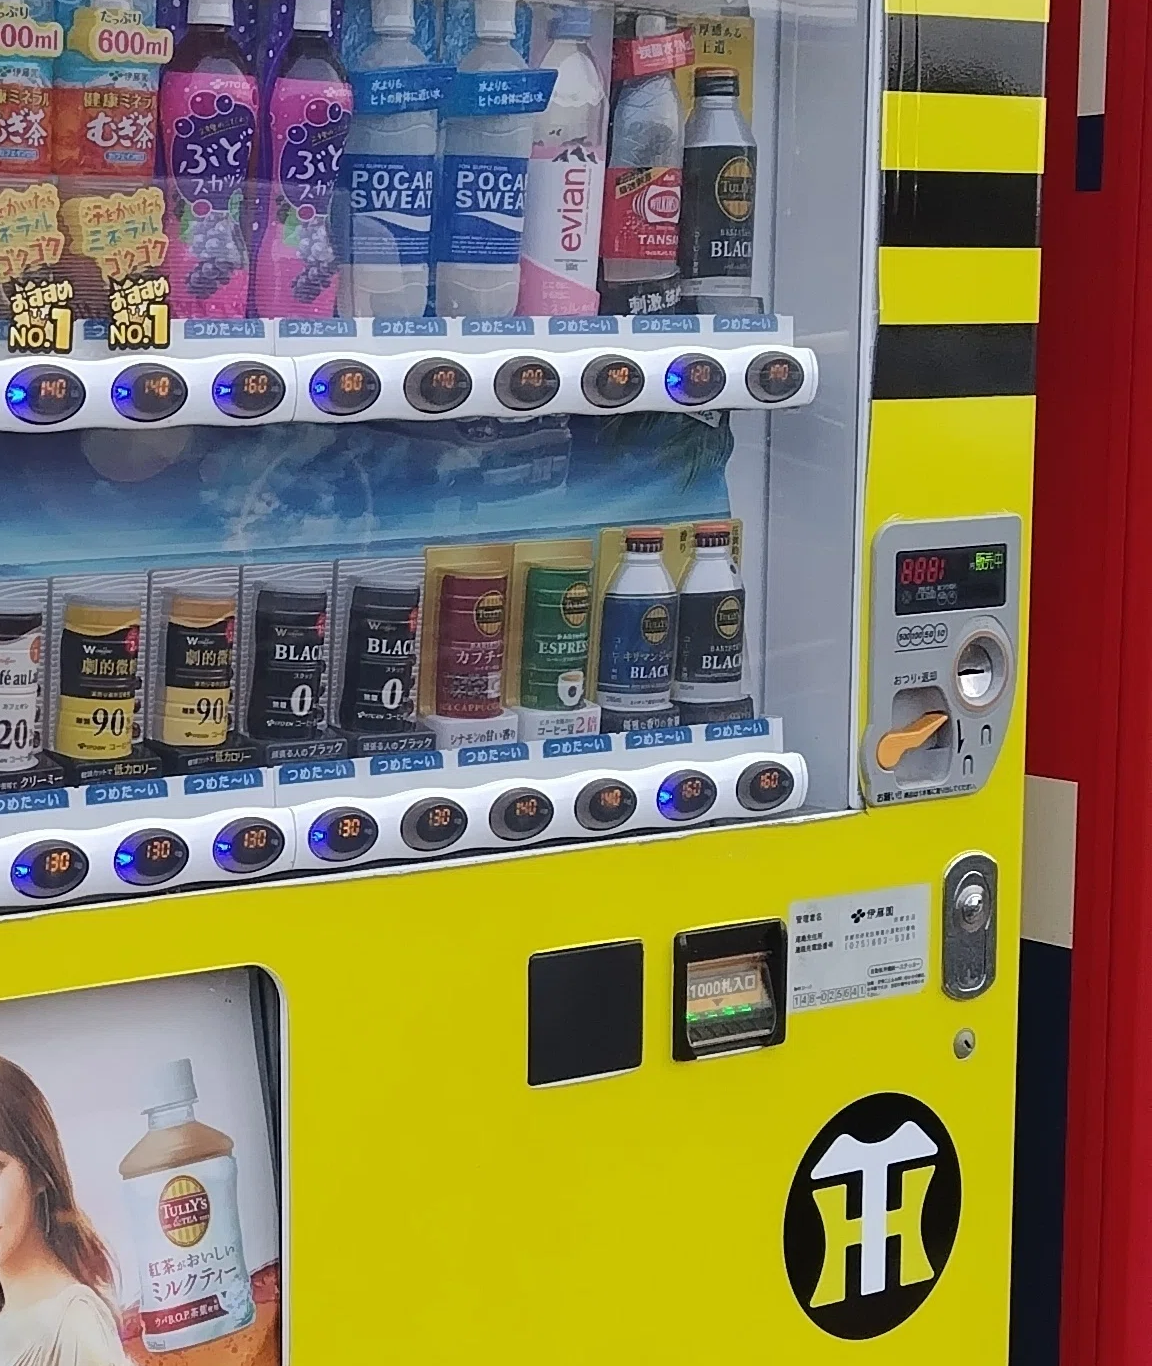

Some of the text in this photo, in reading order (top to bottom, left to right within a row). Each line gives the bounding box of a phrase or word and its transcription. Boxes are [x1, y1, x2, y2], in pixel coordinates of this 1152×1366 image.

[100, 10, 142, 26] たっぷり
[98, 29, 168, 57] 600ml
[86, 111, 156, 149] むぎ茶
[350, 189, 433, 210] SWEAT
[560, 162, 589, 253] evian
[85, 196, 162, 225] 汗をかいたら
[89, 216, 158, 252] ミネラル
[104, 237, 167, 277] ゴクゴク
[10, 280, 73, 314] おすすめ
[109, 276, 169, 313] おすすめ
[9, 308, 72, 350] NO.1
[109, 304, 168, 346] NO.1
[39, 378, 66, 399] 140
[143, 376, 169, 396] 140
[242, 373, 268, 393] 160
[340, 372, 363, 392] 160
[630, 664, 669, 680] BLACK
[91, 707, 125, 737] 90
[20, 774, 64, 789] クリーミー
[682, 779, 702, 797] 160
[760, 770, 780, 789] 160
[515, 799, 537, 817] 140
[600, 788, 622, 807] 140
[337, 818, 361, 838] 130
[428, 808, 451, 827] 130
[243, 829, 267, 849] 130
[146, 841, 171, 861] 130
[45, 852, 71, 873] 130
[689, 974, 756, 999] 1000札入口
[148, 1245, 236, 1278] 紅茶がおいしい
[151, 1266, 238, 1303] ミルクティー
